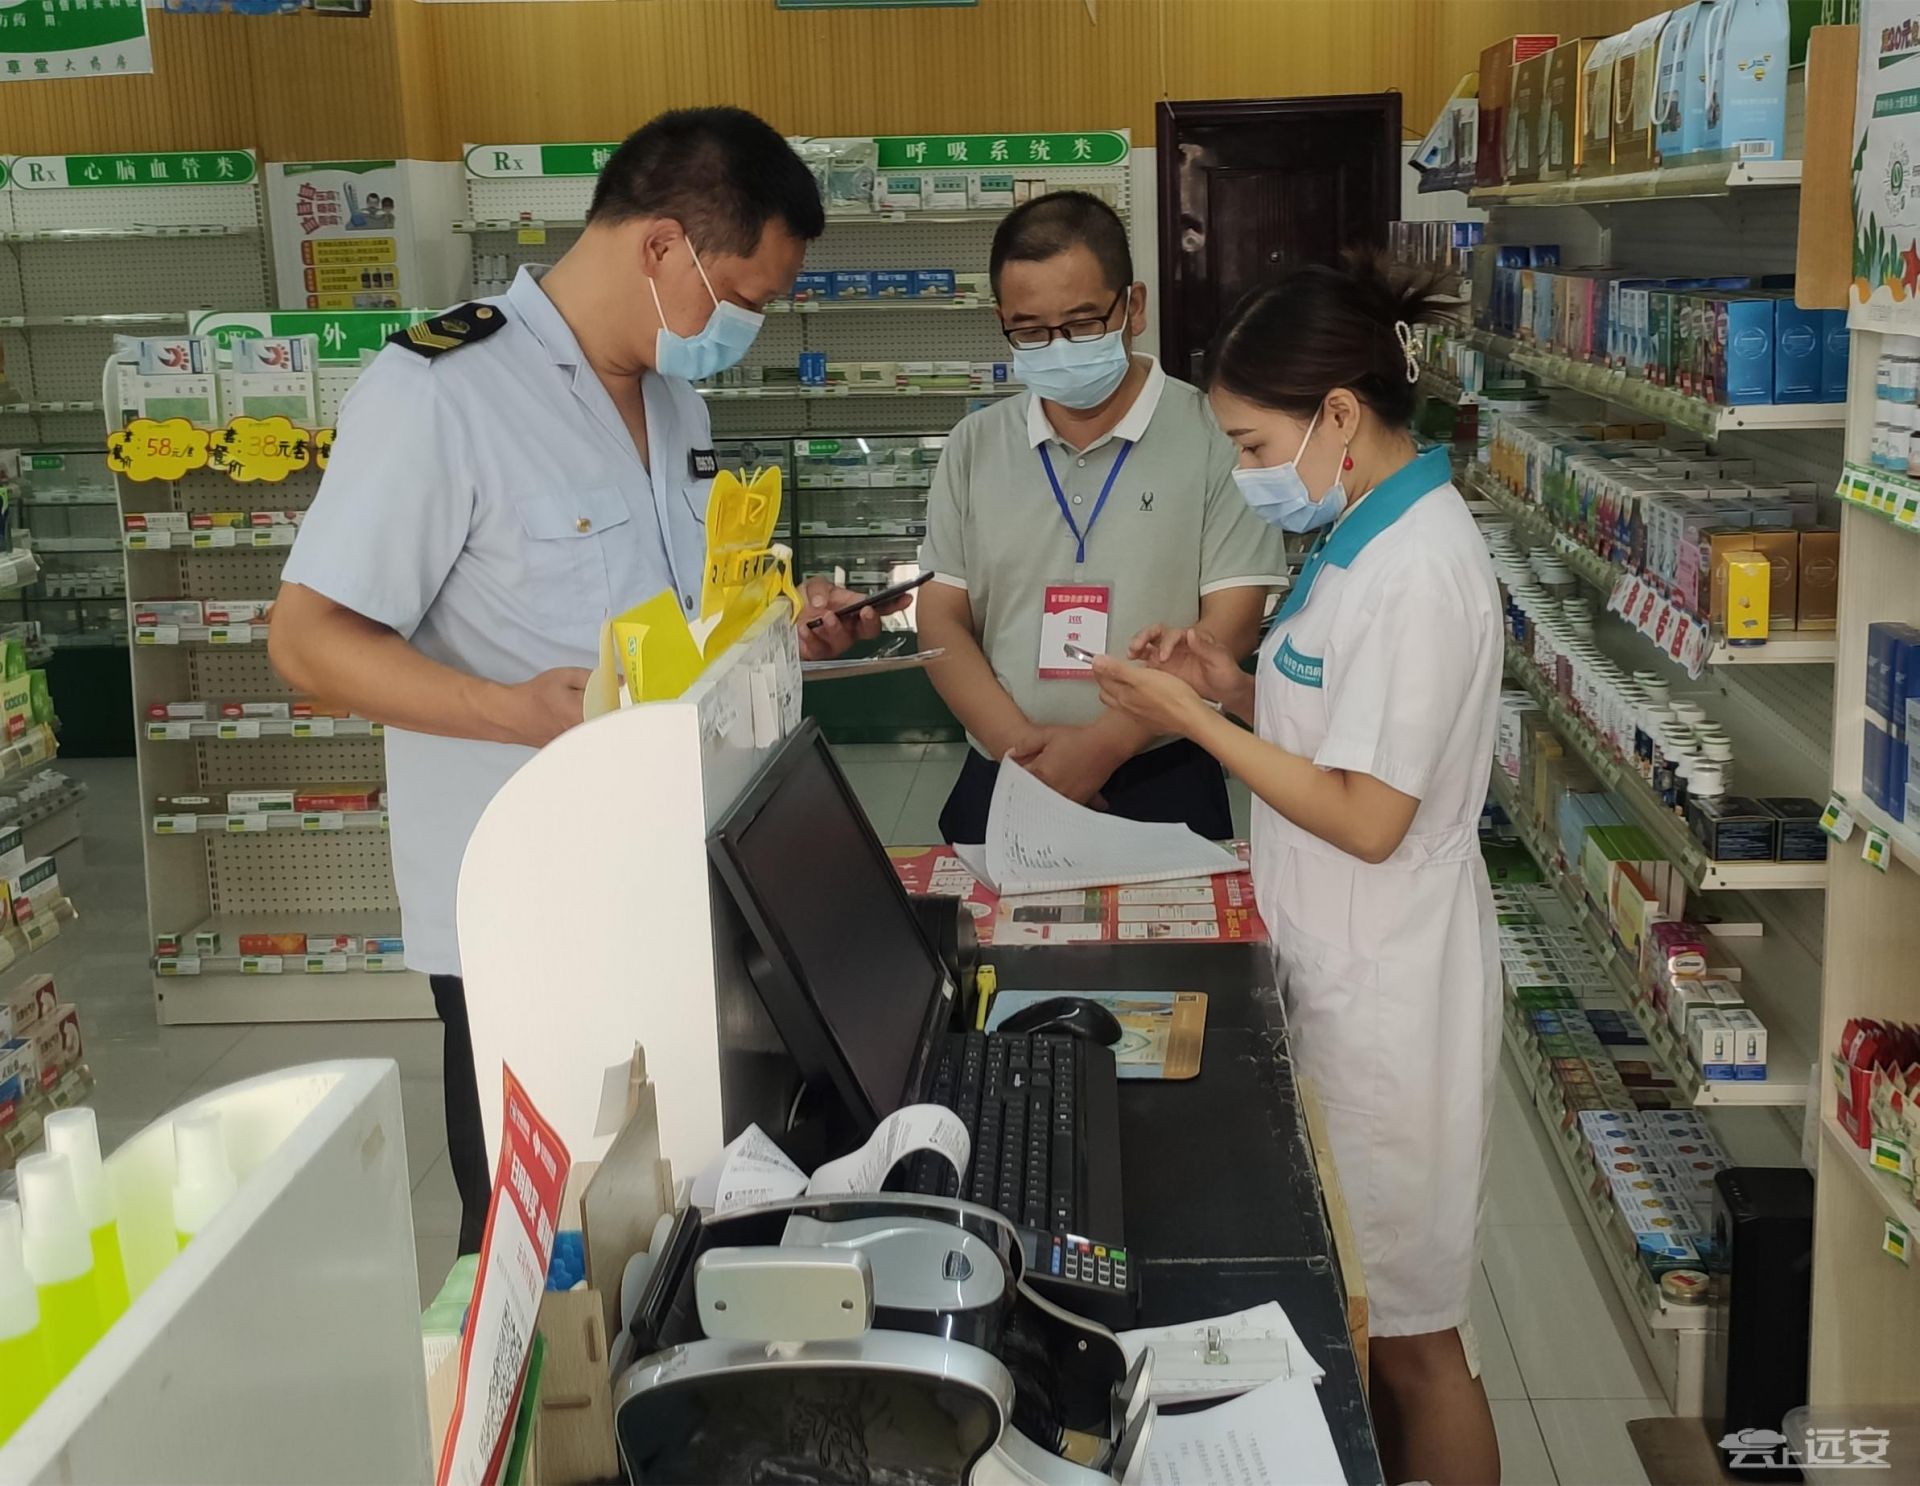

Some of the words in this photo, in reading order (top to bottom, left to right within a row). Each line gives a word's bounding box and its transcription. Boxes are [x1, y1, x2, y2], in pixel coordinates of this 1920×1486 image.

[905, 138, 1093, 163] 呼吸系统类
[84, 156, 235, 182] 心脑血管类
